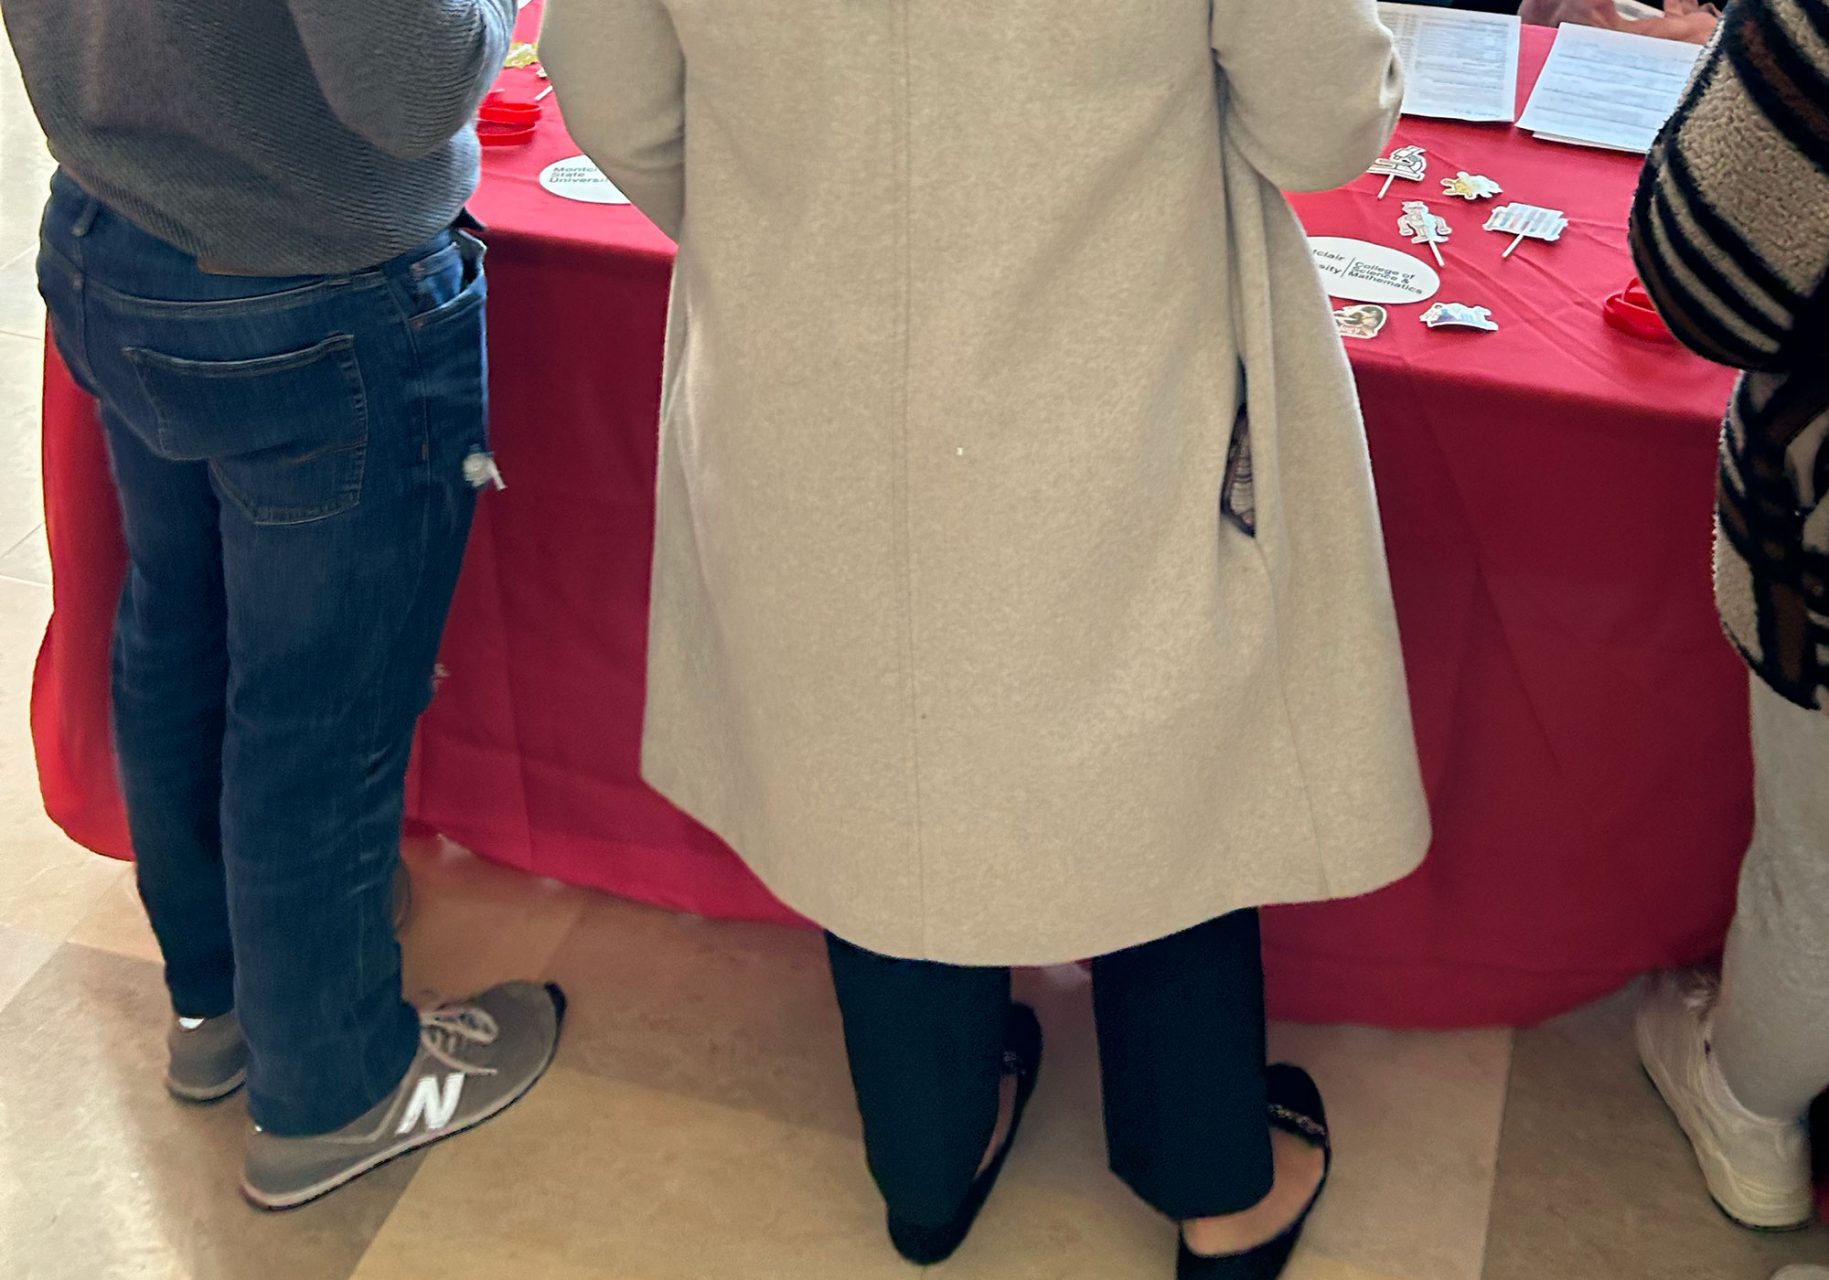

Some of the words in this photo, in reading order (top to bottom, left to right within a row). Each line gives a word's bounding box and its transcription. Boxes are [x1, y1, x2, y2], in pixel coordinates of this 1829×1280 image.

[1352, 266, 1399, 281] Science
[1354, 261, 1400, 276] College
[1402, 272, 1416, 280] of
[1348, 271, 1423, 295] Mathematics
[395, 1072, 466, 1135] N
